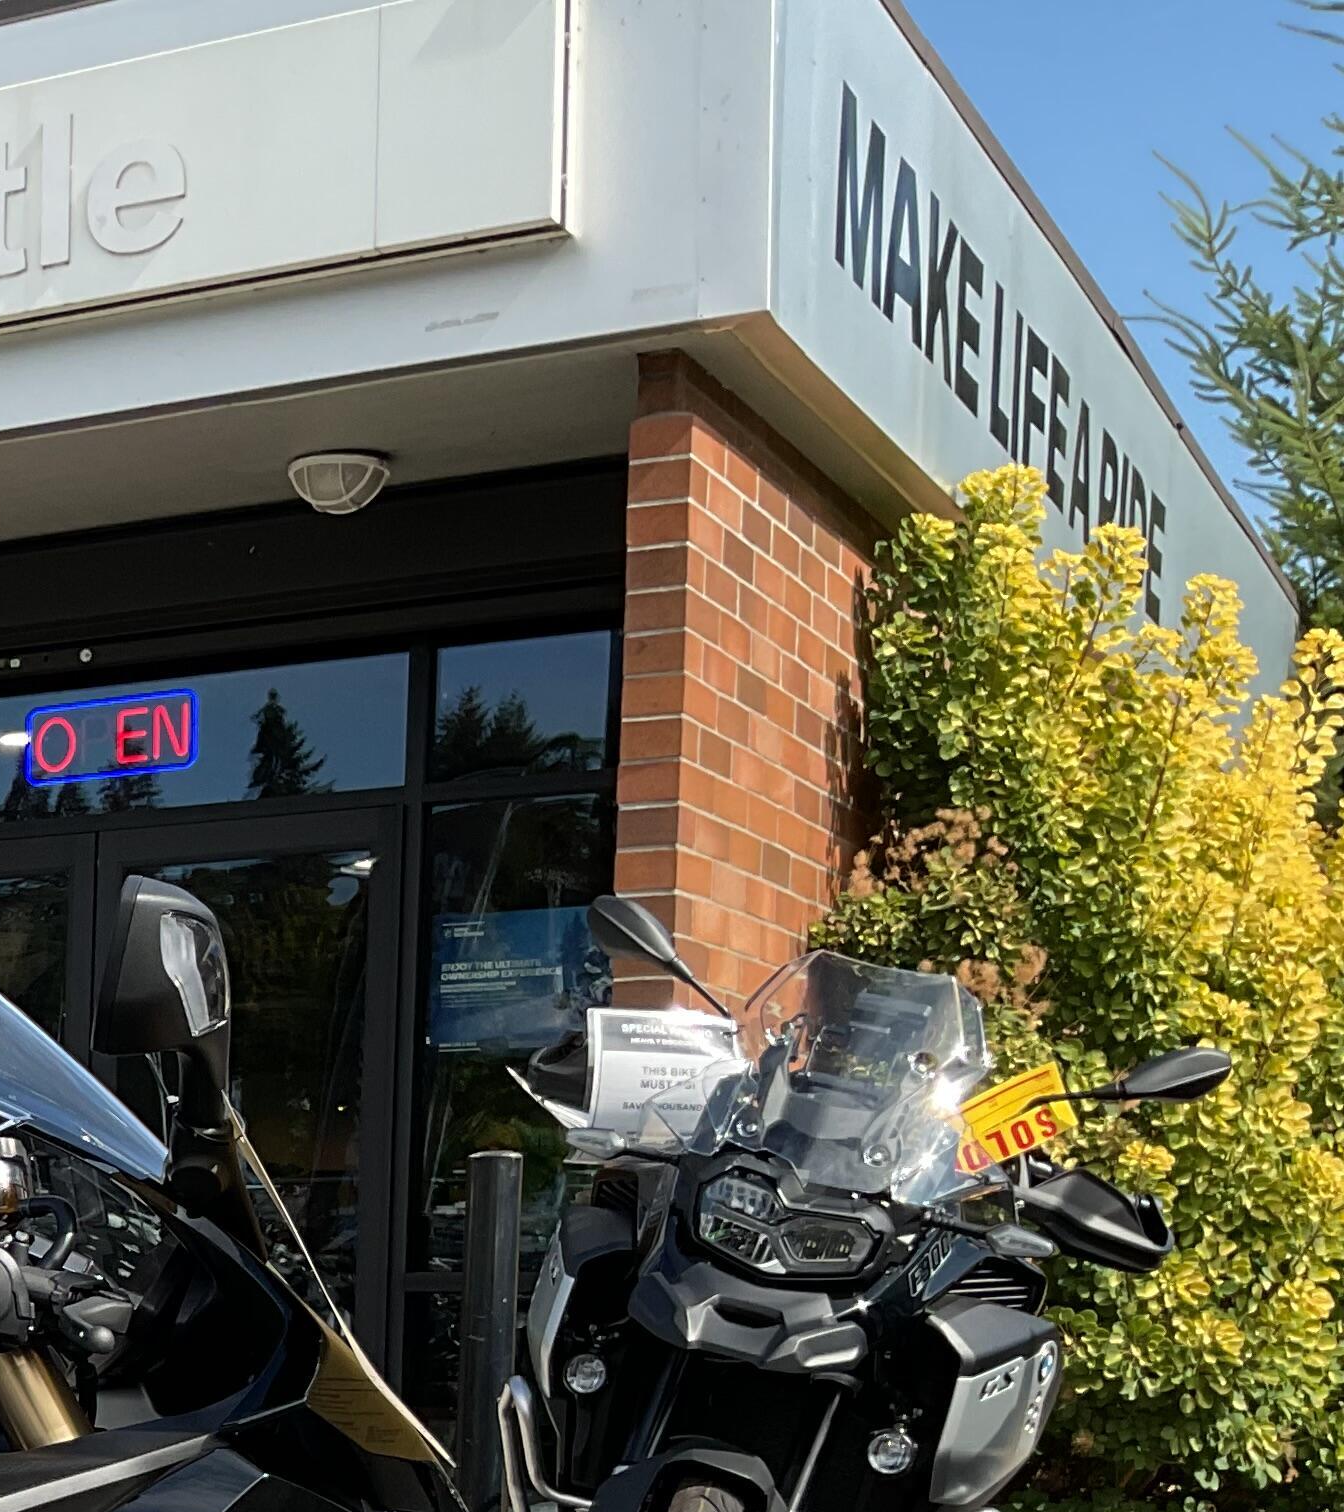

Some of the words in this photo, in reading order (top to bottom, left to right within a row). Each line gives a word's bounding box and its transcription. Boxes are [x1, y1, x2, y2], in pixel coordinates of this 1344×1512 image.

[835, 80, 984, 418] MAKE
[990, 281, 1070, 516] LIFE
[1068, 398, 1091, 546] A
[475, 960, 494, 971] THE
[440, 970, 500, 981] OWNERSHIP
[621, 1023, 667, 1035] SPECIAL
[642, 1066, 667, 1076] THIS
[640, 1079, 673, 1090] MUST
